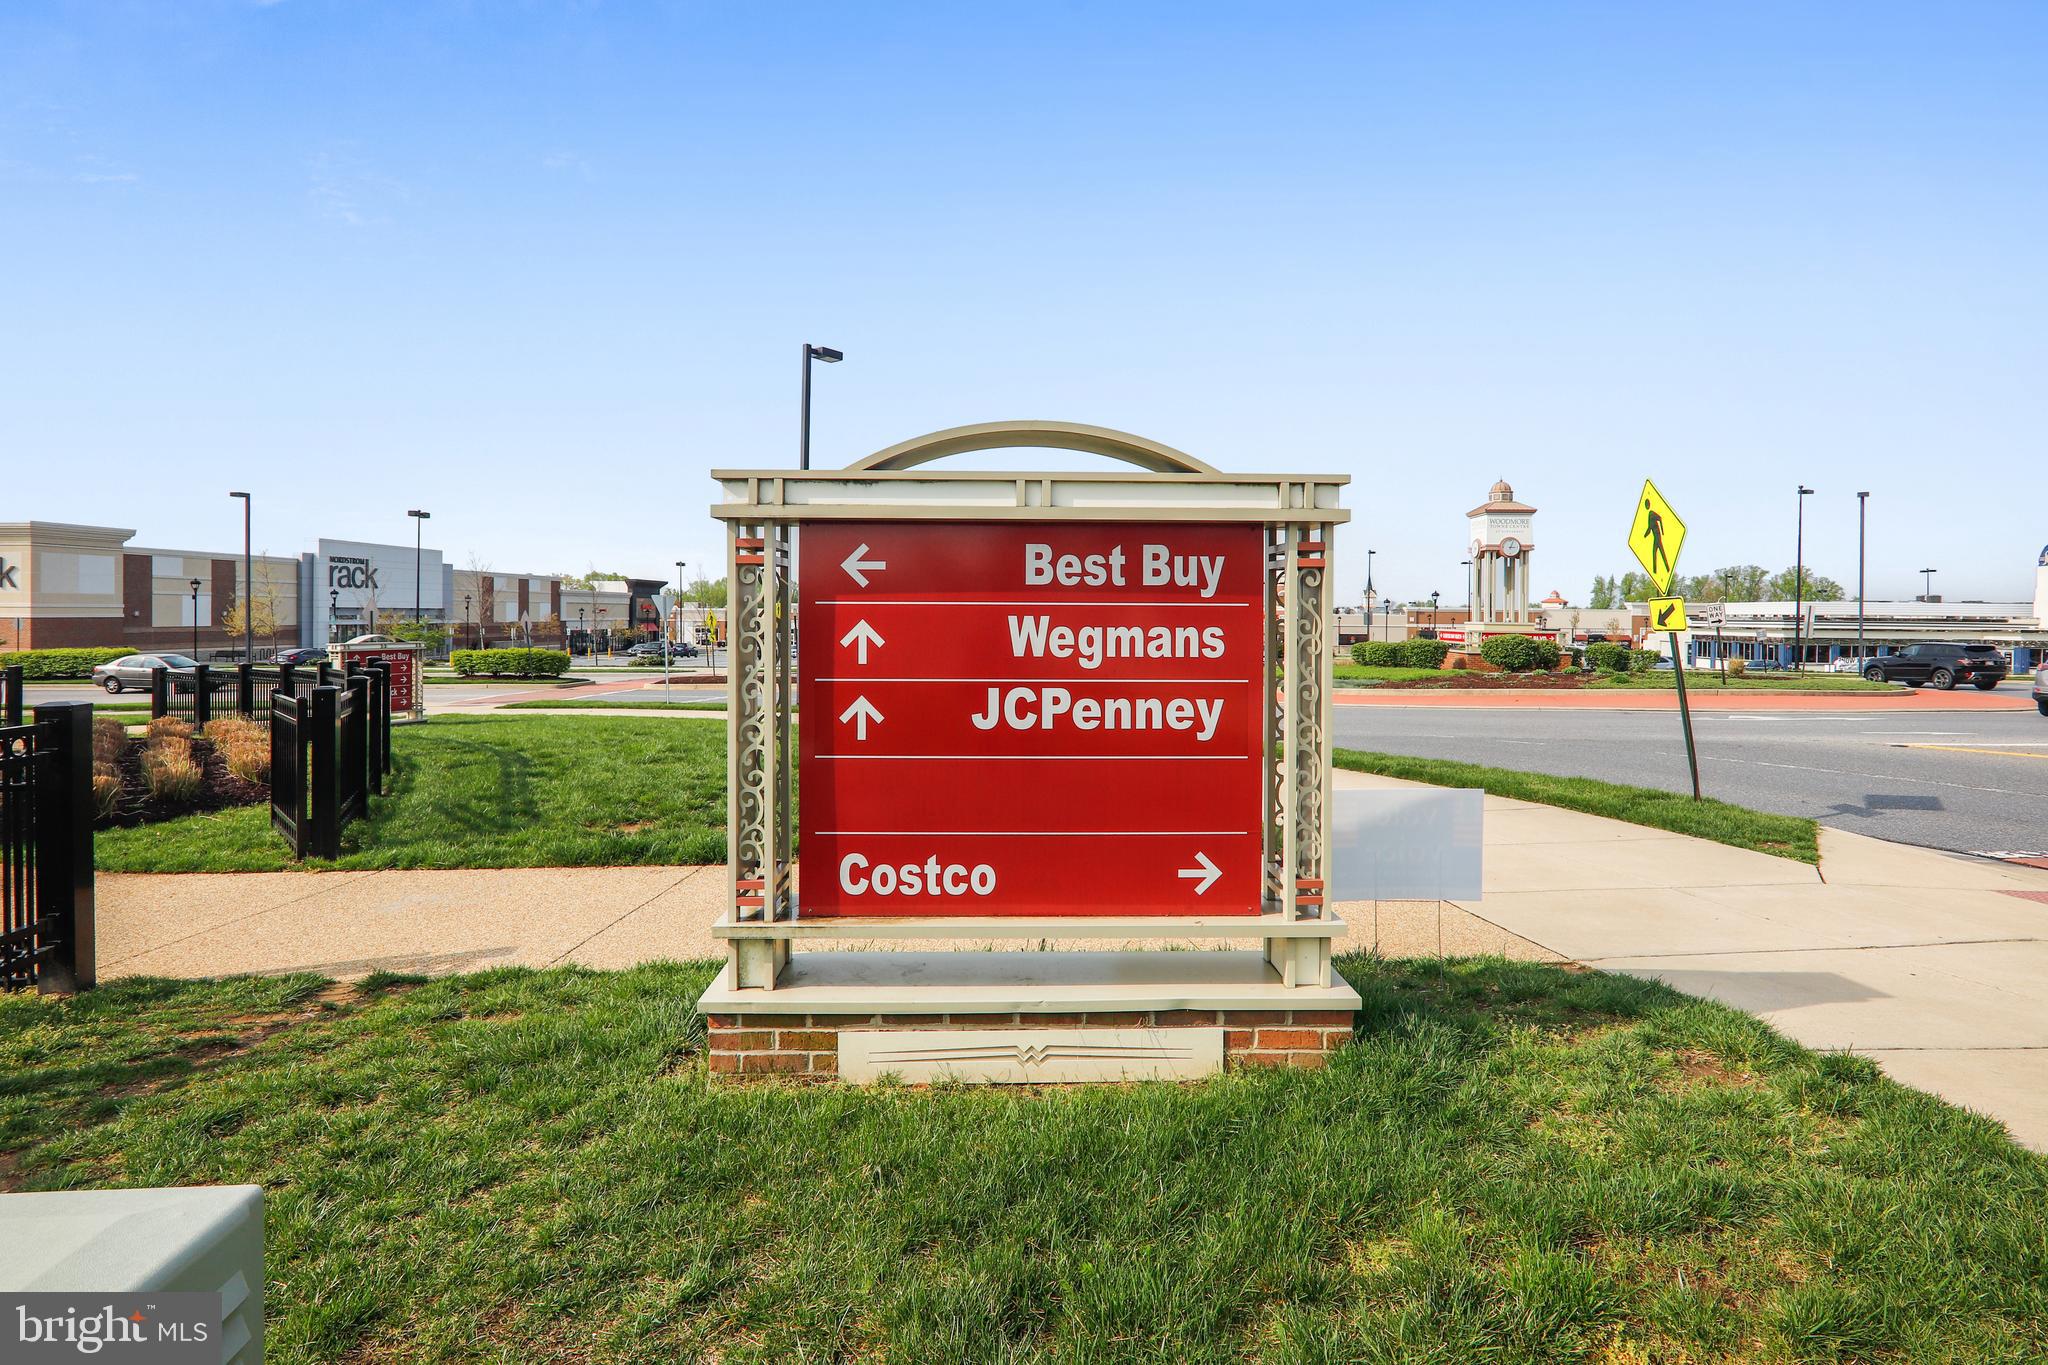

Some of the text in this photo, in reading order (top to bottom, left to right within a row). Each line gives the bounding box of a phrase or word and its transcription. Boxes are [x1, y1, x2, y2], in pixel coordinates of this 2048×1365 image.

[329, 556, 365, 565] NORDSTROM
[329, 558, 379, 589] rack
[1024, 543, 1226, 598] Best Buy
[381, 652, 410, 661] Best Buy
[1007, 615, 1227, 670] Wegmans
[971, 686, 1226, 741] JCPenney
[839, 852, 997, 896] Costco
